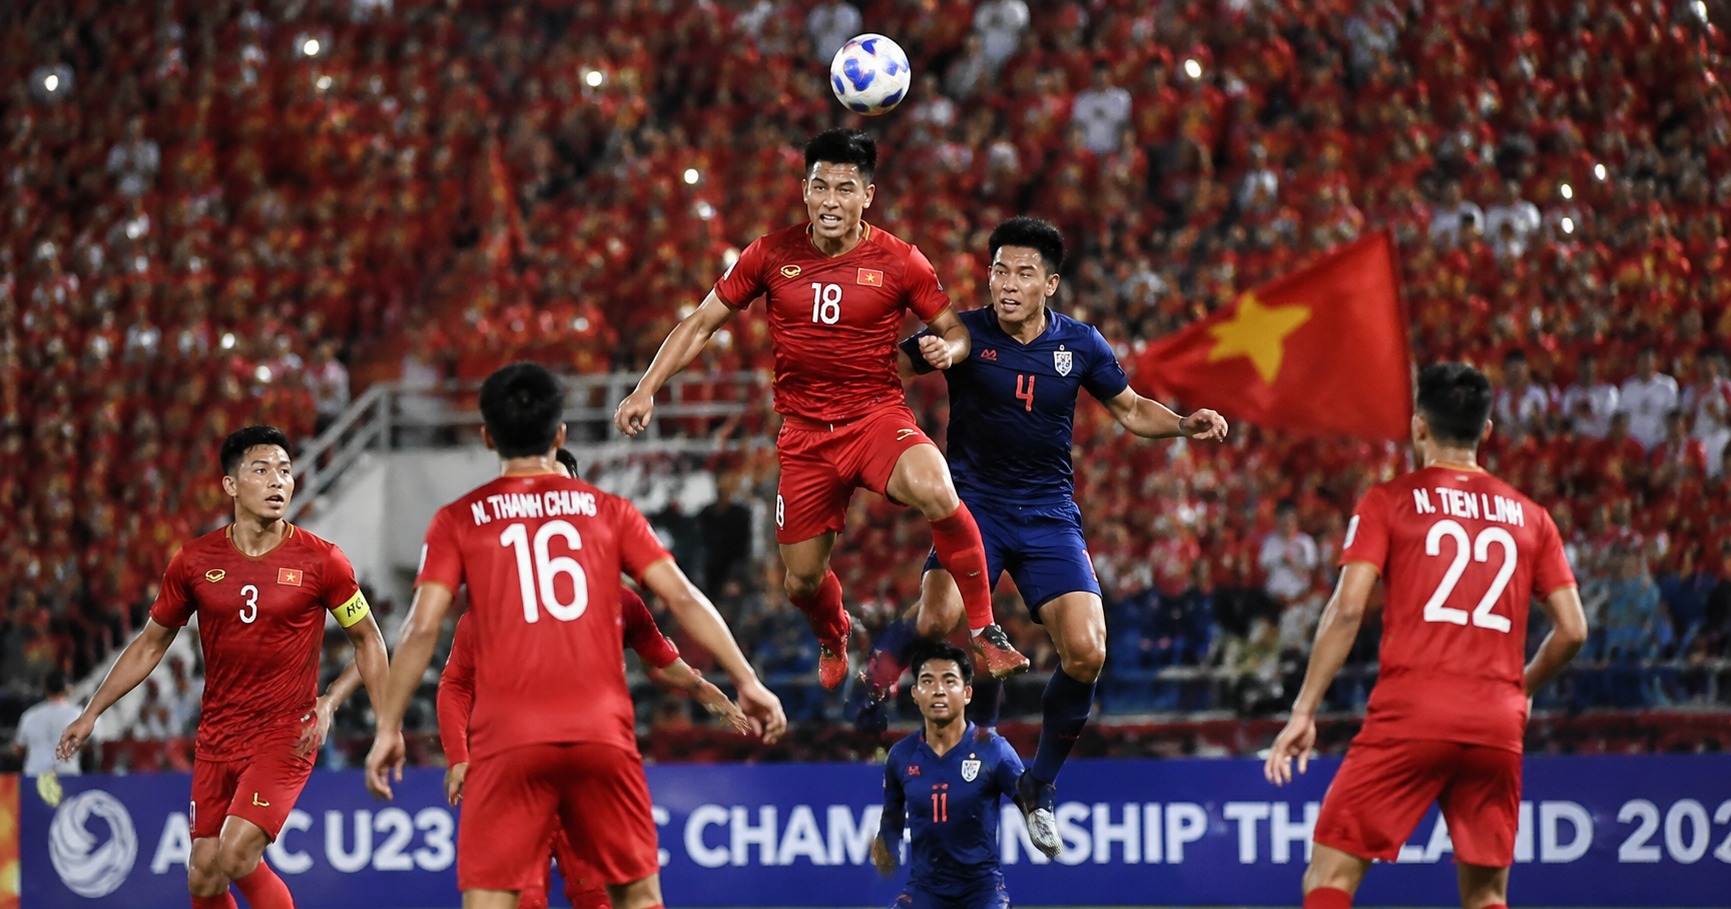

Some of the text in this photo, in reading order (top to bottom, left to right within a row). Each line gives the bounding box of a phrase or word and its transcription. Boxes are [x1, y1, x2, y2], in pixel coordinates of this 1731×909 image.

[811, 282, 842, 325] 18
[1015, 374, 1035, 412] 4
[470, 490, 597, 527] N. THANH CHUNG
[1413, 486, 1525, 528] N. TIEN LINH
[500, 519, 589, 624] 16
[1423, 519, 1518, 634] 22
[239, 584, 259, 624] 3
[931, 793, 948, 823] 11
[151, 807, 314, 874] AC
[324, 806, 455, 873] U23
[684, 801, 1208, 868] CHAMNSHIP
